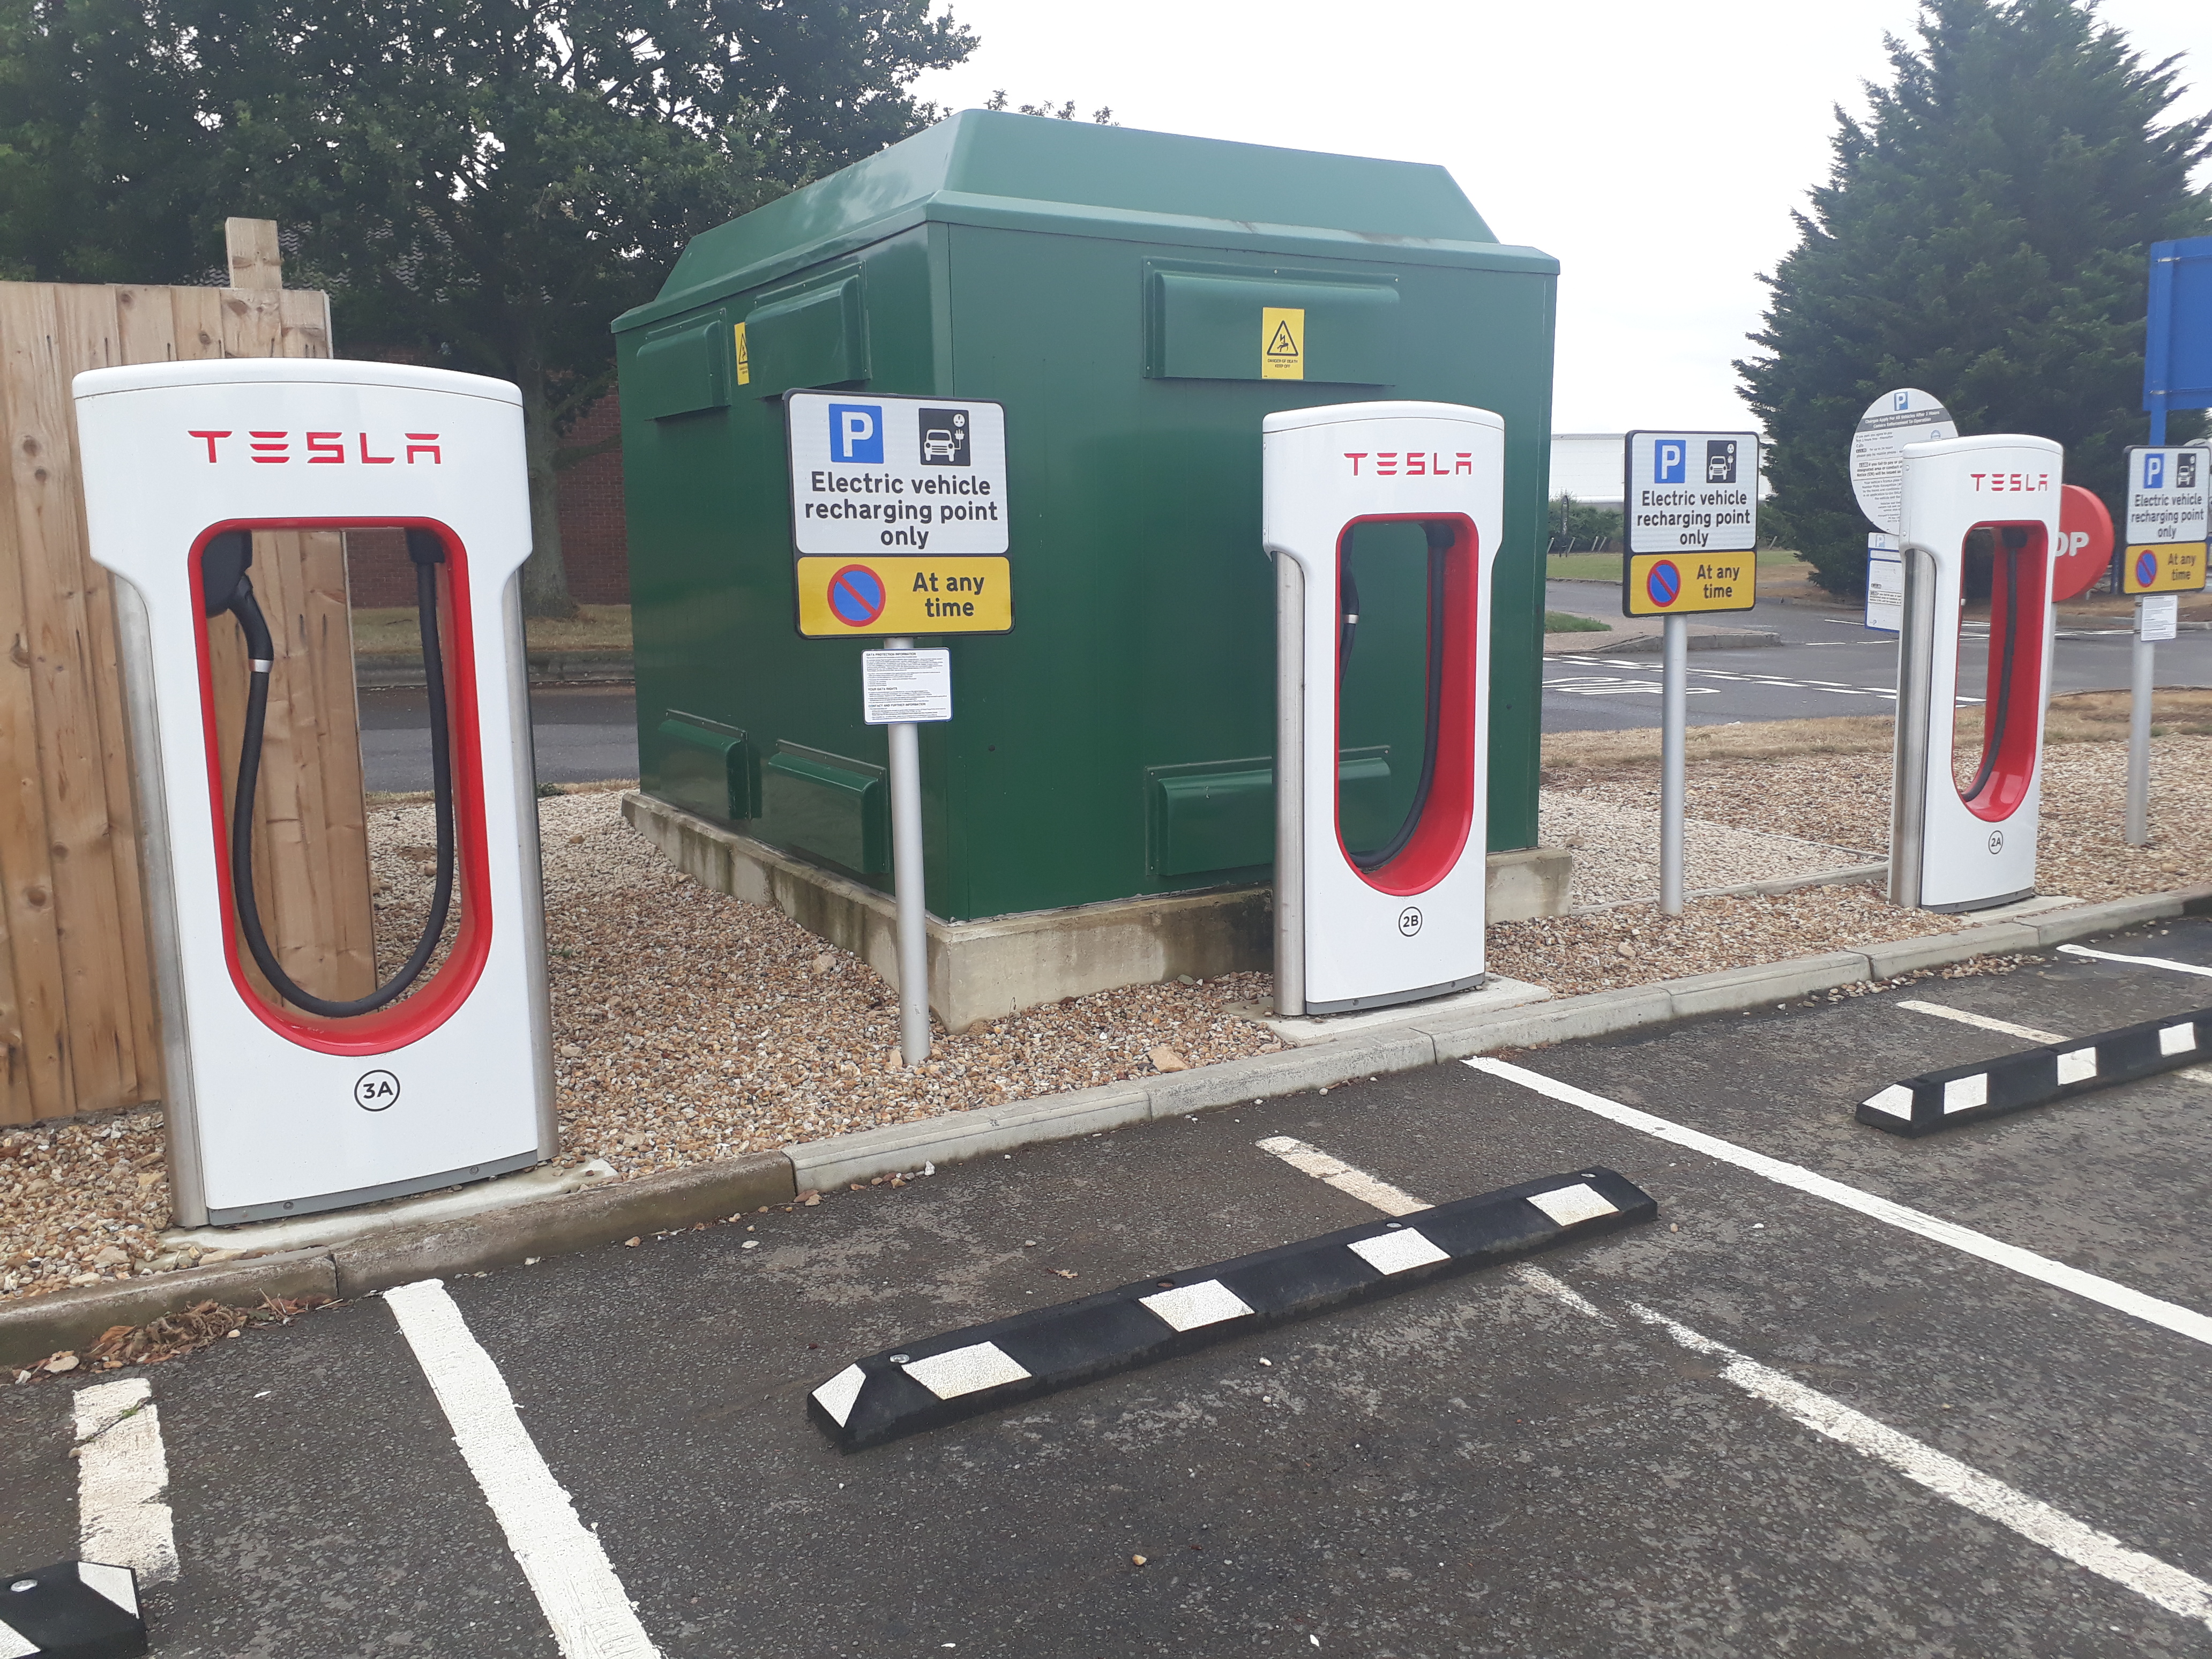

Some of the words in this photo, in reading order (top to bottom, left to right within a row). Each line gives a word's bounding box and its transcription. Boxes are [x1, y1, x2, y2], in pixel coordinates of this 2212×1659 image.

[188, 430, 441, 464] TESLA
[1344, 453, 1473, 476] TESLA
[811, 471, 904, 494] Electric
[911, 475, 991, 496] vehicle
[1970, 474, 2048, 491] TESLA
[1642, 490, 1695, 506] Electric
[1700, 489, 1747, 505] vehicle
[2134, 494, 2169, 507] Electric
[2171, 492, 2202, 506] vehicle
[805, 499, 932, 524] recharging
[940, 501, 998, 524] point
[1637, 510, 1711, 528] recharging
[1716, 509, 1751, 527] point
[2131, 509, 2179, 525] recharging
[2180, 508, 2204, 523] point
[880, 526, 929, 550] only
[1679, 529, 1709, 548] only
[2157, 525, 2177, 540] only
[2168, 553, 2178, 565] At
[2180, 554, 2196, 567] any
[1697, 564, 1713, 580] At
[1717, 566, 1740, 581] any
[2171, 569, 2191, 581] time
[913, 572, 939, 592] At
[946, 577, 985, 595] any
[1703, 584, 1732, 599] time
[925, 598, 974, 618] time
[1991, 837, 2001, 847] 2A
[1403, 915, 1419, 928] 2B
[363, 1081, 394, 1099] 3A
